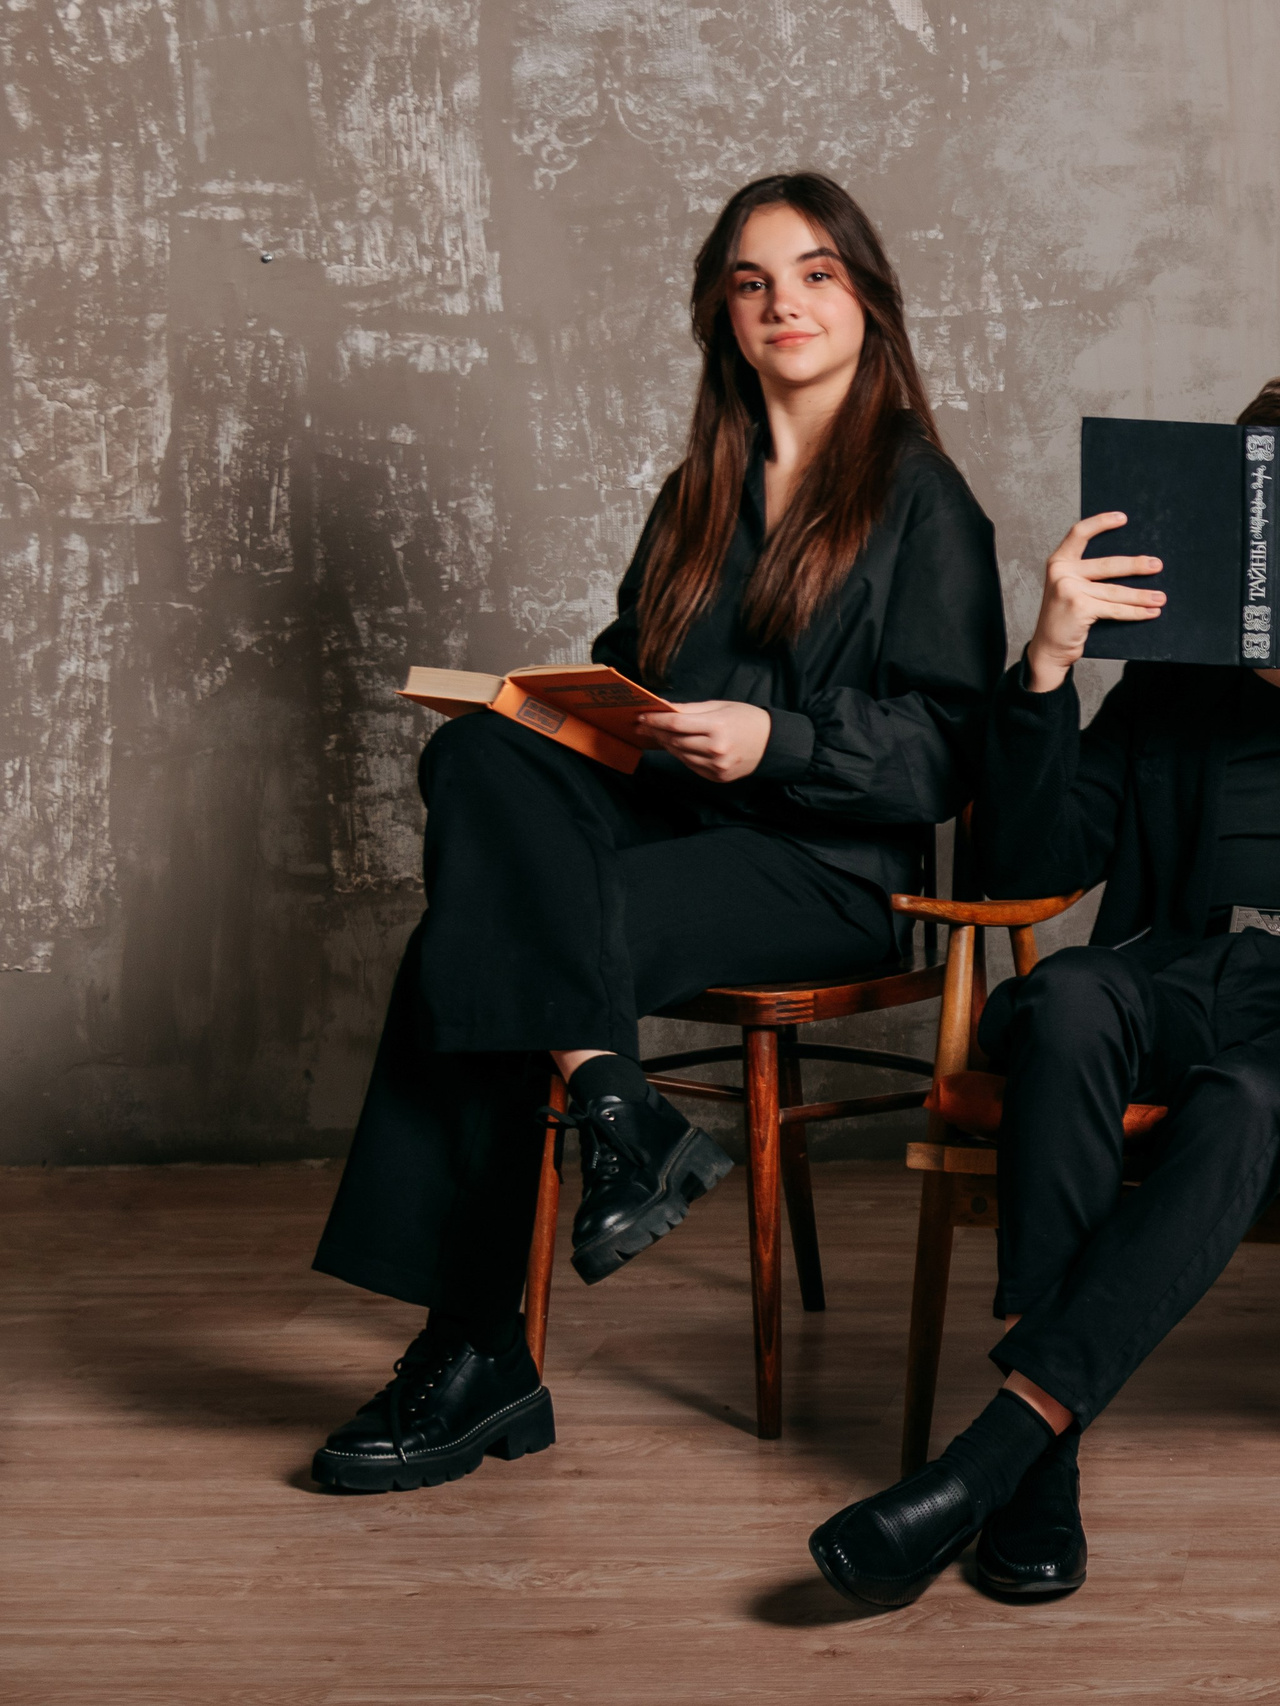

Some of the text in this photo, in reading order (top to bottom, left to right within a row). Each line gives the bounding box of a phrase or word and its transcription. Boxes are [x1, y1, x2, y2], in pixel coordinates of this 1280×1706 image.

[1246, 464, 1273, 601] ТАЙНЫ Мадридского двора
